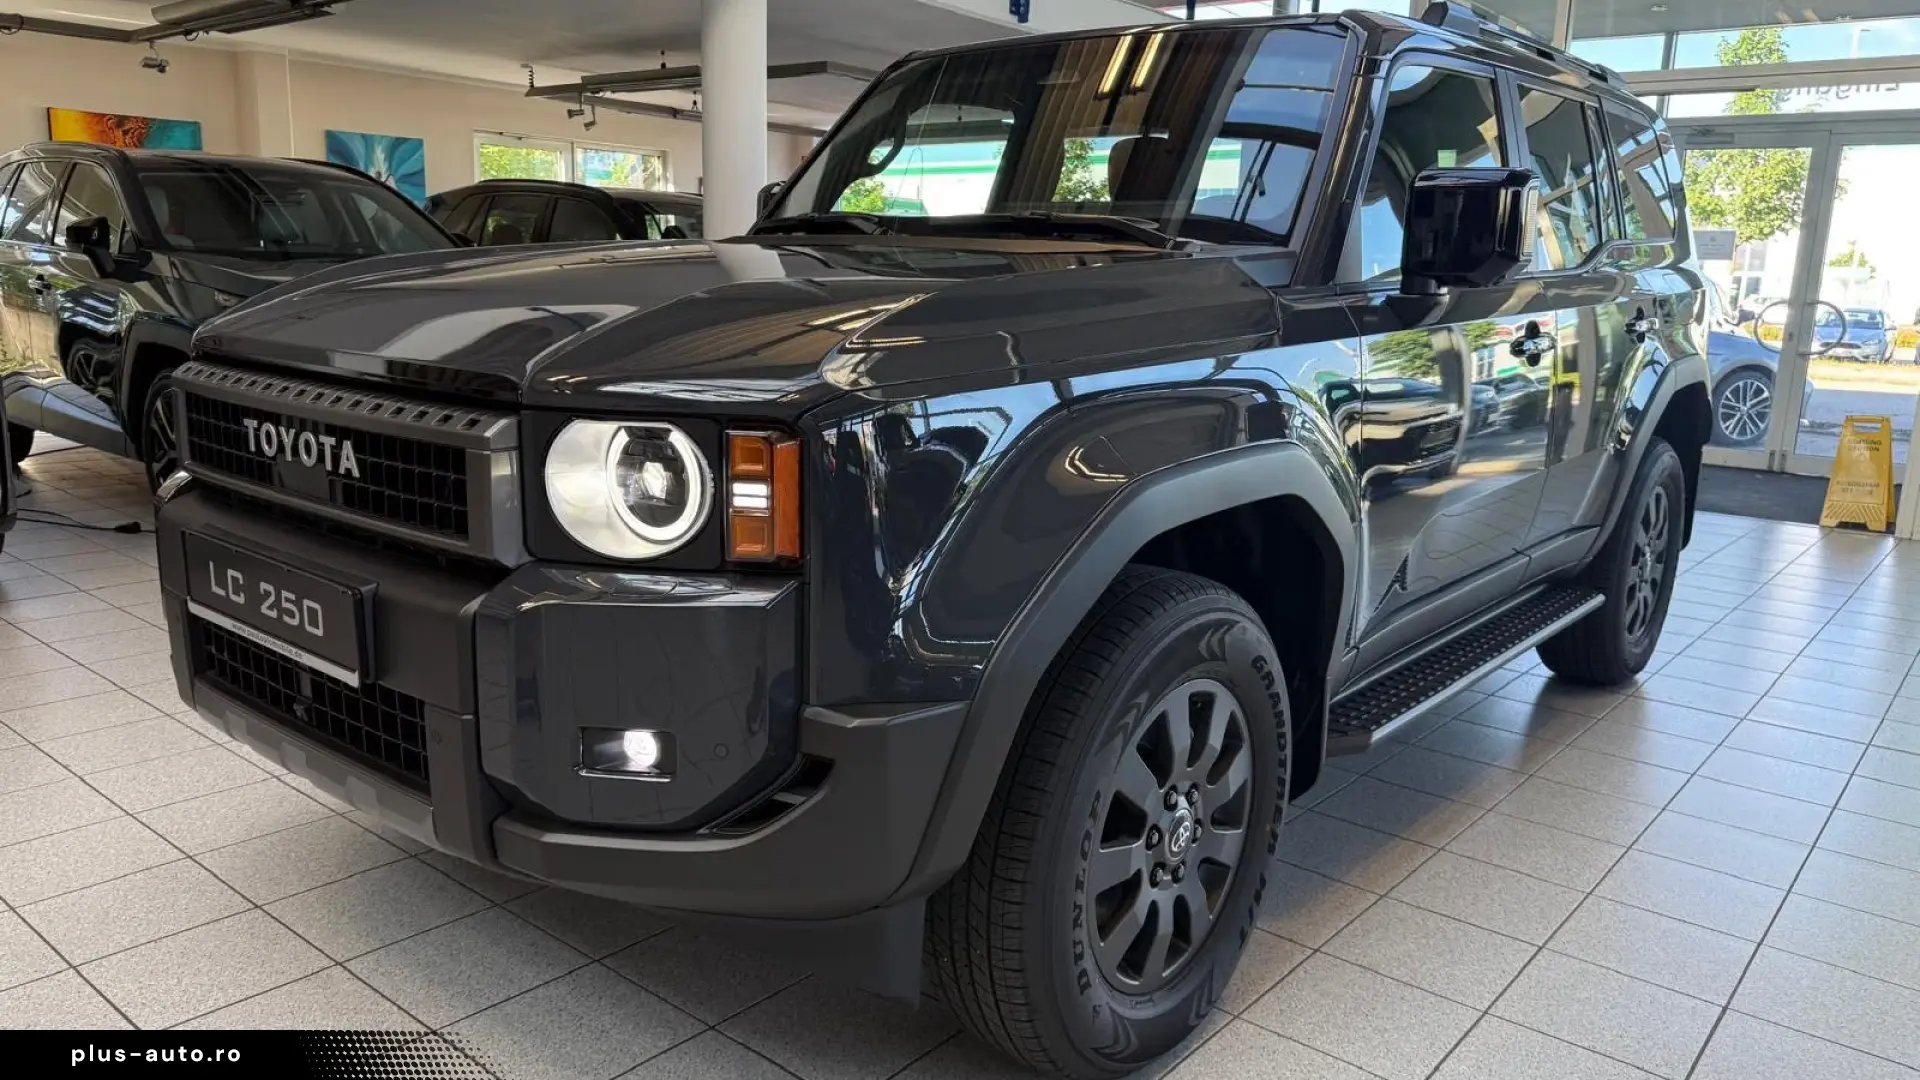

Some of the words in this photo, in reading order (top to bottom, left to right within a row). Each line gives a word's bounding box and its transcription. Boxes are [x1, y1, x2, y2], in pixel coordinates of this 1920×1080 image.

[243, 418, 360, 478] TOYOTA
[208, 561, 245, 604] LC
[258, 580, 324, 637] 250
[1073, 790, 1102, 996] DUNLOP
